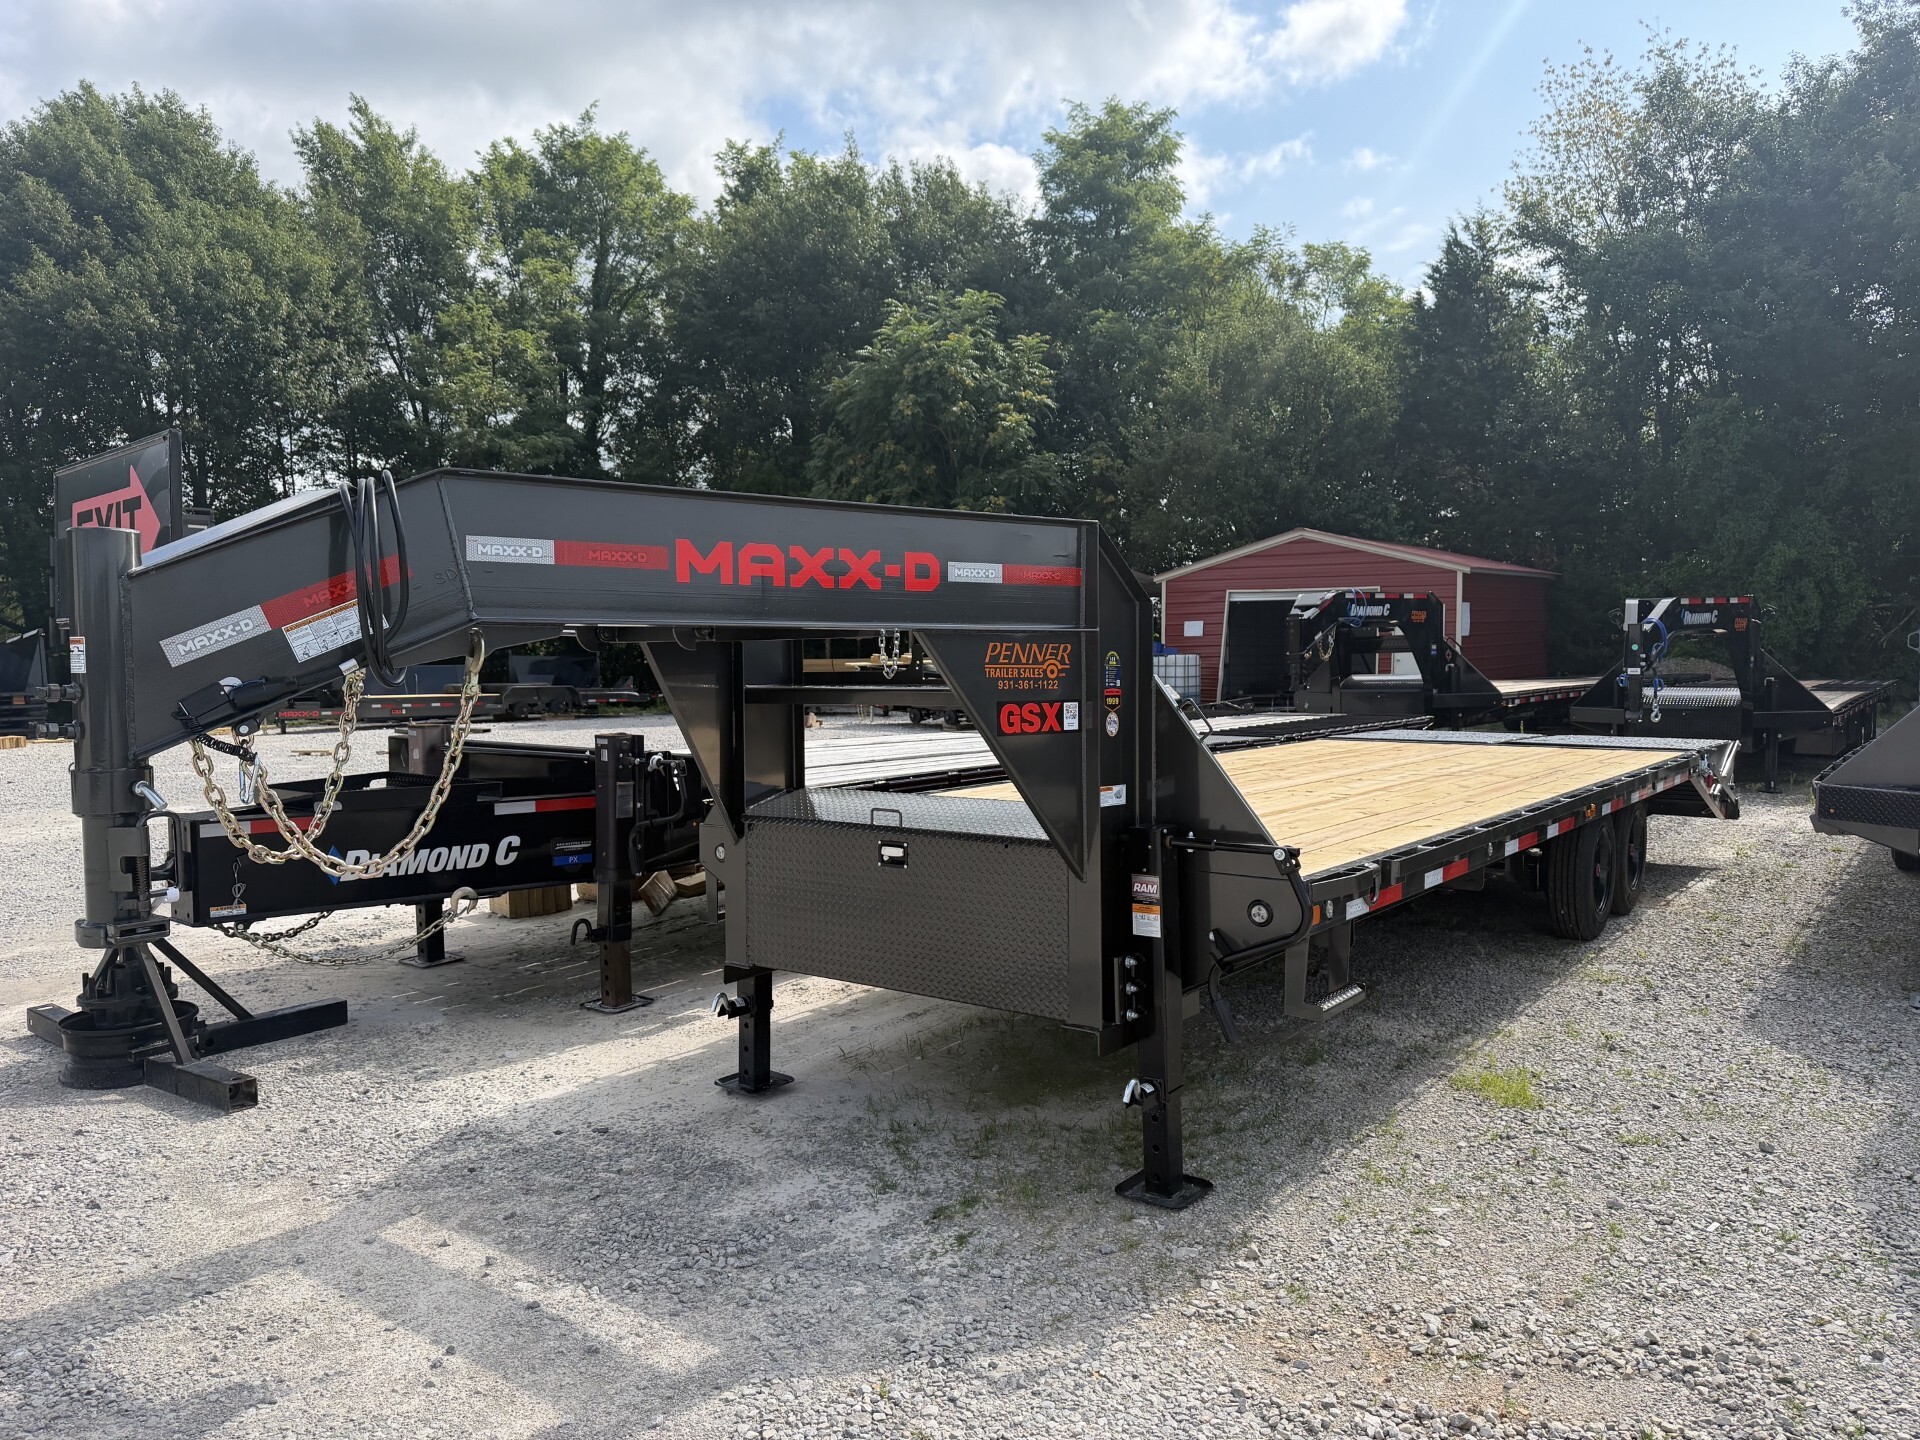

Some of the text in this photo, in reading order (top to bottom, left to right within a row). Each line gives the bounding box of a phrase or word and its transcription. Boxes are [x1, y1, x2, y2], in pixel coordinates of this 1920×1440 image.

[477, 543, 543, 558] MAXX-D
[588, 549, 647, 563] MAXX-D
[675, 538, 940, 592] MAXX-D
[954, 567, 996, 579] MAXX-D
[302, 581, 358, 608] MAXX
[176, 618, 254, 656] MAXX-D
[985, 642, 1072, 664] PENNER
[985, 668, 1044, 678] TRAILER SALES
[998, 680, 1059, 690] 931-361-1122
[1000, 702, 1062, 734] GSX
[495, 835, 521, 866] C
[569, 856, 578, 864] PX
[1133, 882, 1158, 893] RAM
